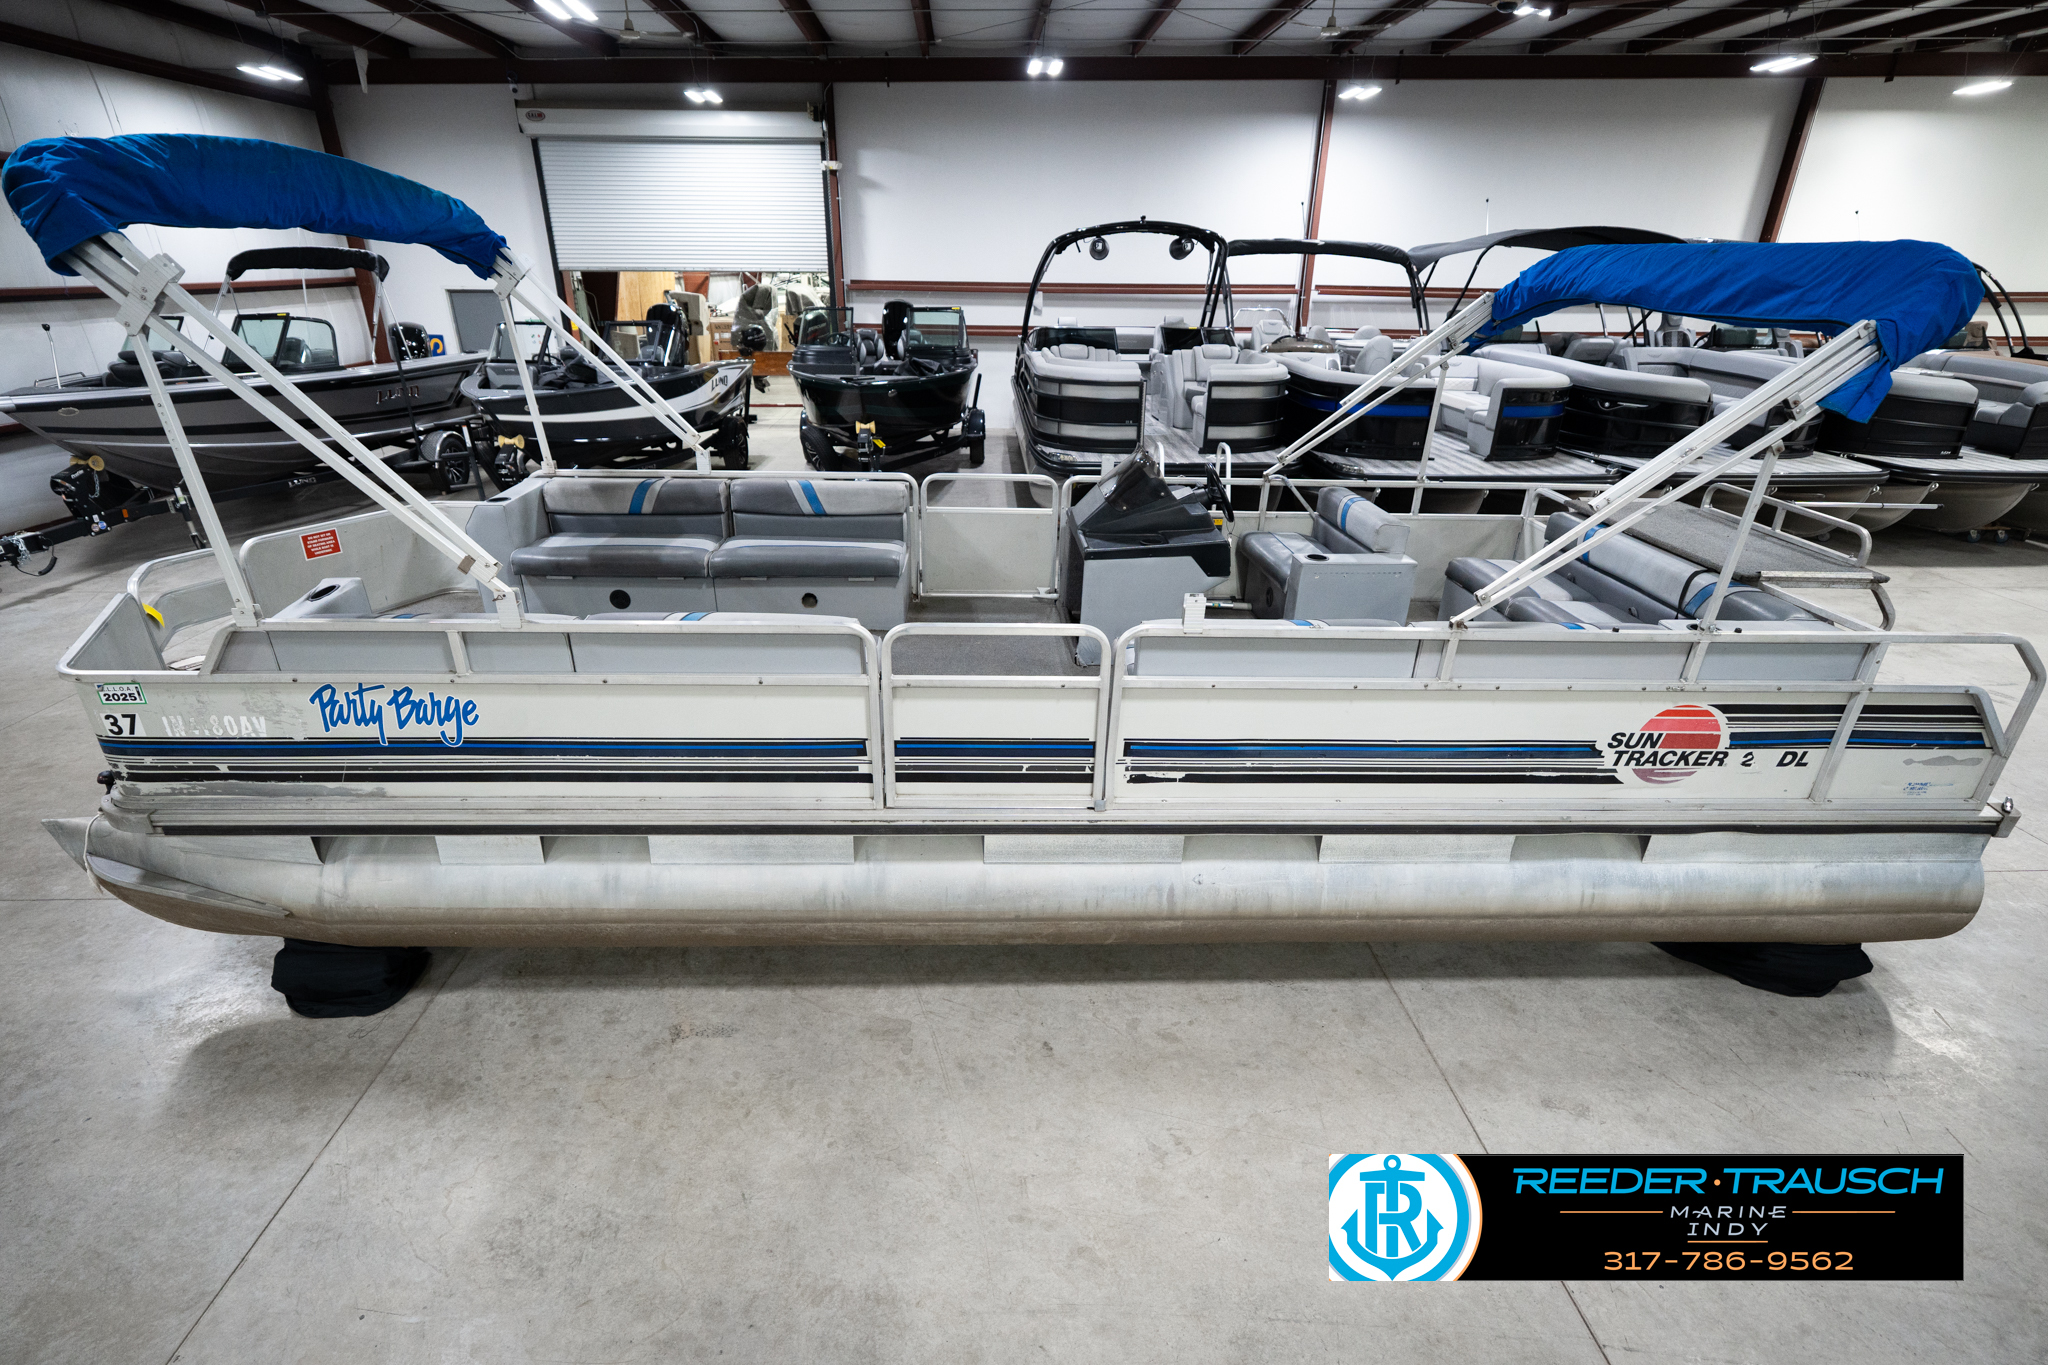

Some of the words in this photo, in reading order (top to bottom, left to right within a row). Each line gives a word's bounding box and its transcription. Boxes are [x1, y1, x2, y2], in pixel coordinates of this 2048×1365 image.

[711, 375, 728, 391] LUND
[103, 692, 138, 702] 2025
[309, 682, 388, 746] Party
[386, 685, 480, 747] Barge
[104, 714, 136, 735] 37
[1607, 732, 1664, 749] SUN
[1612, 750, 1729, 767] TRACKER
